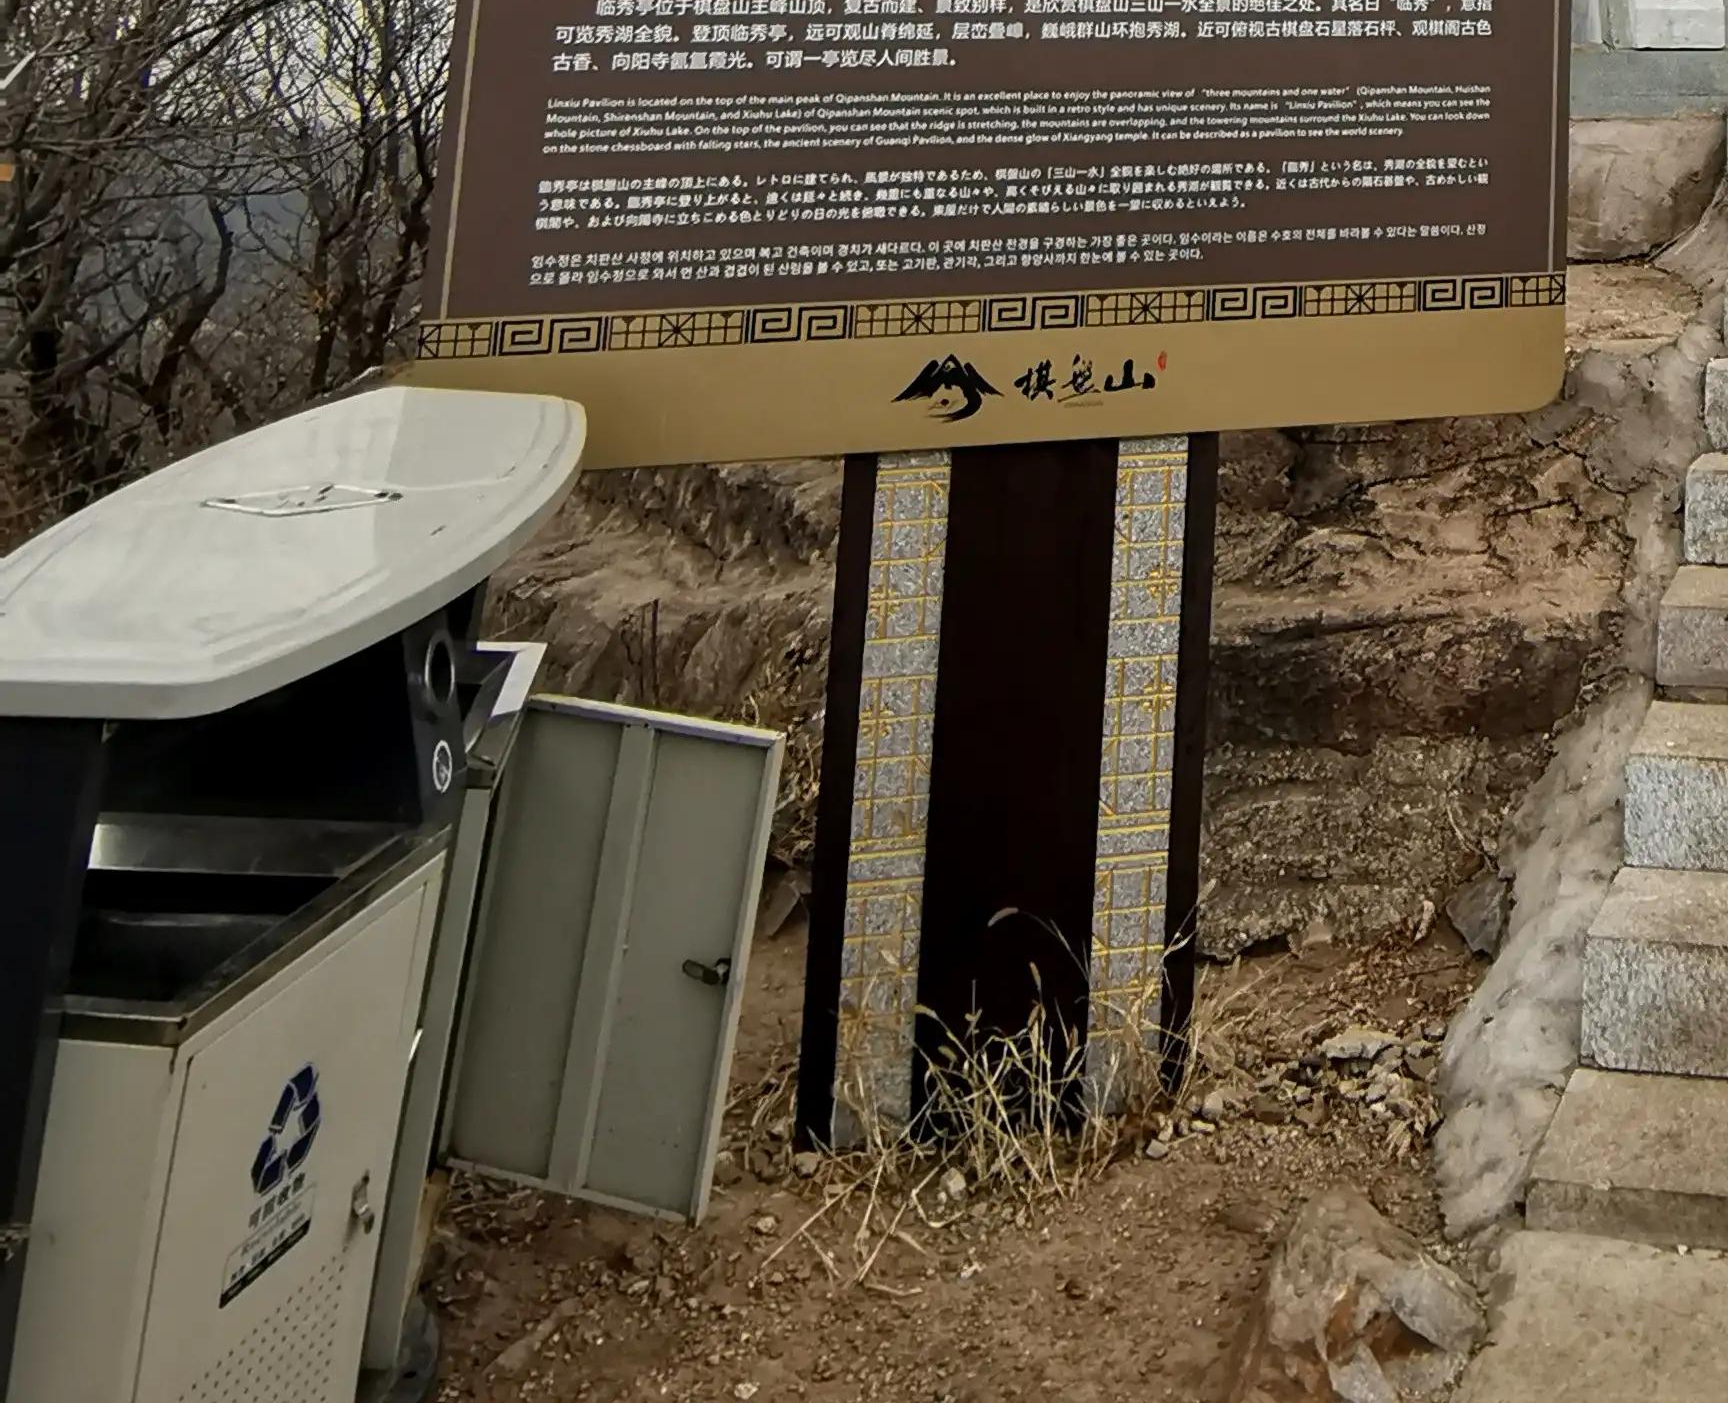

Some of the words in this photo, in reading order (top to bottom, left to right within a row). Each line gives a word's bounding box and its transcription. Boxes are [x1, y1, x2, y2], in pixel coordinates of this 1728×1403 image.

[581, 97, 625, 108] Pavilion
[637, 95, 678, 107] located
[767, 94, 794, 104] main
[795, 93, 820, 106] peak
[834, 92, 889, 104] Qipanshan
[977, 90, 1022, 101] excellent
[1022, 90, 1050, 102] place
[1063, 90, 1091, 102] enjoy
[1109, 90, 1160, 101] panoramic
[1161, 89, 1184, 98] view
[1231, 88, 1281, 97] mountains
[741, 108, 773, 119] Xiuhu
[816, 107, 871, 120] Qipanshan
[872, 106, 921, 117] Mountain
[922, 107, 954, 116] scenic
[981, 104, 1011, 115] which
[1022, 103, 1046, 115] built
[1066, 104, 1091, 114] retro
[1092, 103, 1116, 115] style
[1155, 102, 1188, 113] unique
[1242, 102, 1269, 111] name
[1364, 98, 1392, 109] which
[1392, 100, 1422, 108] means
[543, 127, 578, 139] whole
[577, 127, 618, 140] picture
[631, 126, 664, 136] Xiuhu
[887, 120, 909, 131] that
[928, 119, 956, 132] ridge
[1039, 118, 1090, 128] mountains
[1206, 116, 1248, 127] towering
[1249, 115, 1298, 124] mountains
[1298, 113, 1340, 123] surround
[1357, 112, 1385, 122] Xiuhu
[1444, 111, 1465, 121] look
[1465, 111, 1490, 120] down
[578, 142, 610, 153] stone
[610, 140, 672, 152] chessboard
[673, 140, 697, 150] with
[697, 139, 732, 152] falling
[781, 137, 821, 148] ancient
[822, 138, 862, 148] scenery
[994, 133, 1024, 143] dense
[1025, 132, 1049, 145] glow
[1062, 132, 1114, 143] Xiangyang
[1192, 129, 1239, 140] described
[1258, 127, 1296, 140] pavilion
[1340, 126, 1368, 136] world
[1368, 127, 1403, 137] scenery
[1013, 353, 1157, 403] 棋盘山
